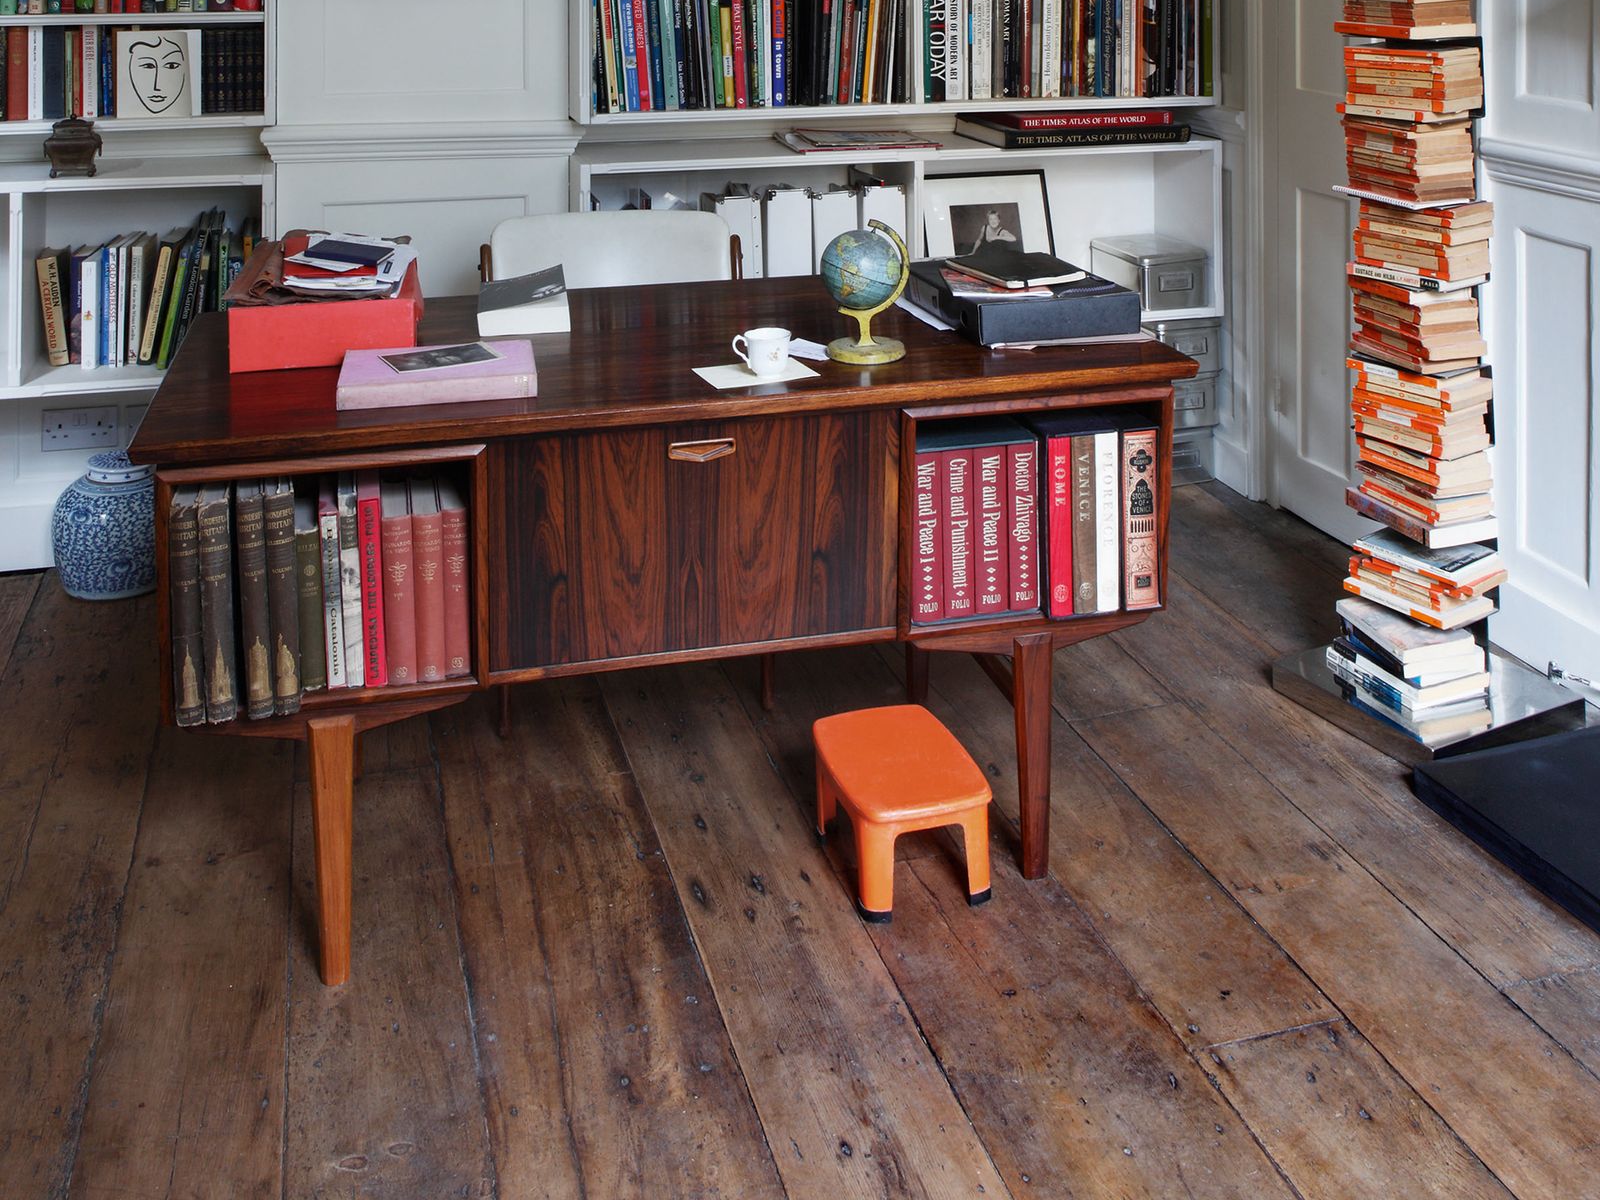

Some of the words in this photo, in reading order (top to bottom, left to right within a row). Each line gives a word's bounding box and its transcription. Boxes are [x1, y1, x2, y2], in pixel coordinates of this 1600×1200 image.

[625, 3, 633, 27] dream
[950, 23, 957, 32] OF
[776, 41, 782, 50] in
[678, 73, 686, 104] Lovatt-Smith
[1103, 116, 1118, 124] THE
[1119, 115, 1146, 123] WORLD
[1016, 136, 1034, 144] THE
[1036, 135, 1063, 144] TIMES
[1066, 134, 1098, 143] ATLAS
[1101, 133, 1113, 141] OF
[1115, 133, 1136, 141] THE
[1138, 132, 1176, 140] WORLD
[187, 266, 199, 292] London
[1354, 267, 1373, 277] EUSTACE
[1383, 272, 1396, 280] HILDA
[43, 288, 53, 319] CERTAIN
[50, 281, 60, 307] AUDEN
[182, 293, 195, 320] Garden
[46, 322, 57, 349] WORLD
[917, 461, 936, 489] War
[949, 458, 968, 493] Crime
[982, 454, 1000, 483] War
[1015, 452, 1033, 491] Doctor
[1054, 455, 1067, 507] ROME
[982, 486, 1001, 509] and
[1078, 454, 1090, 522] VENICE
[1101, 452, 1114, 547] FLORENCE
[1131, 491, 1152, 500] STONES
[918, 493, 936, 516] and
[950, 496, 968, 517] and
[1132, 505, 1152, 514] VENICE
[363, 507, 373, 535] FOLIO
[982, 511, 1001, 546] Peace
[1012, 494, 1034, 542] Zhivago
[918, 518, 937, 554] Peace
[365, 543, 376, 588] LEOPARD
[950, 519, 969, 589] Punishment
[983, 549, 998, 562] II
[367, 591, 377, 610] THE
[919, 602, 938, 613] FOLIO
[951, 598, 970, 609] FOLIO
[982, 594, 1001, 604] FOLIO
[1015, 590, 1034, 601] FOLIO
[330, 608, 340, 676] Catalonia
[369, 618, 380, 680] LAMPEDUSA
